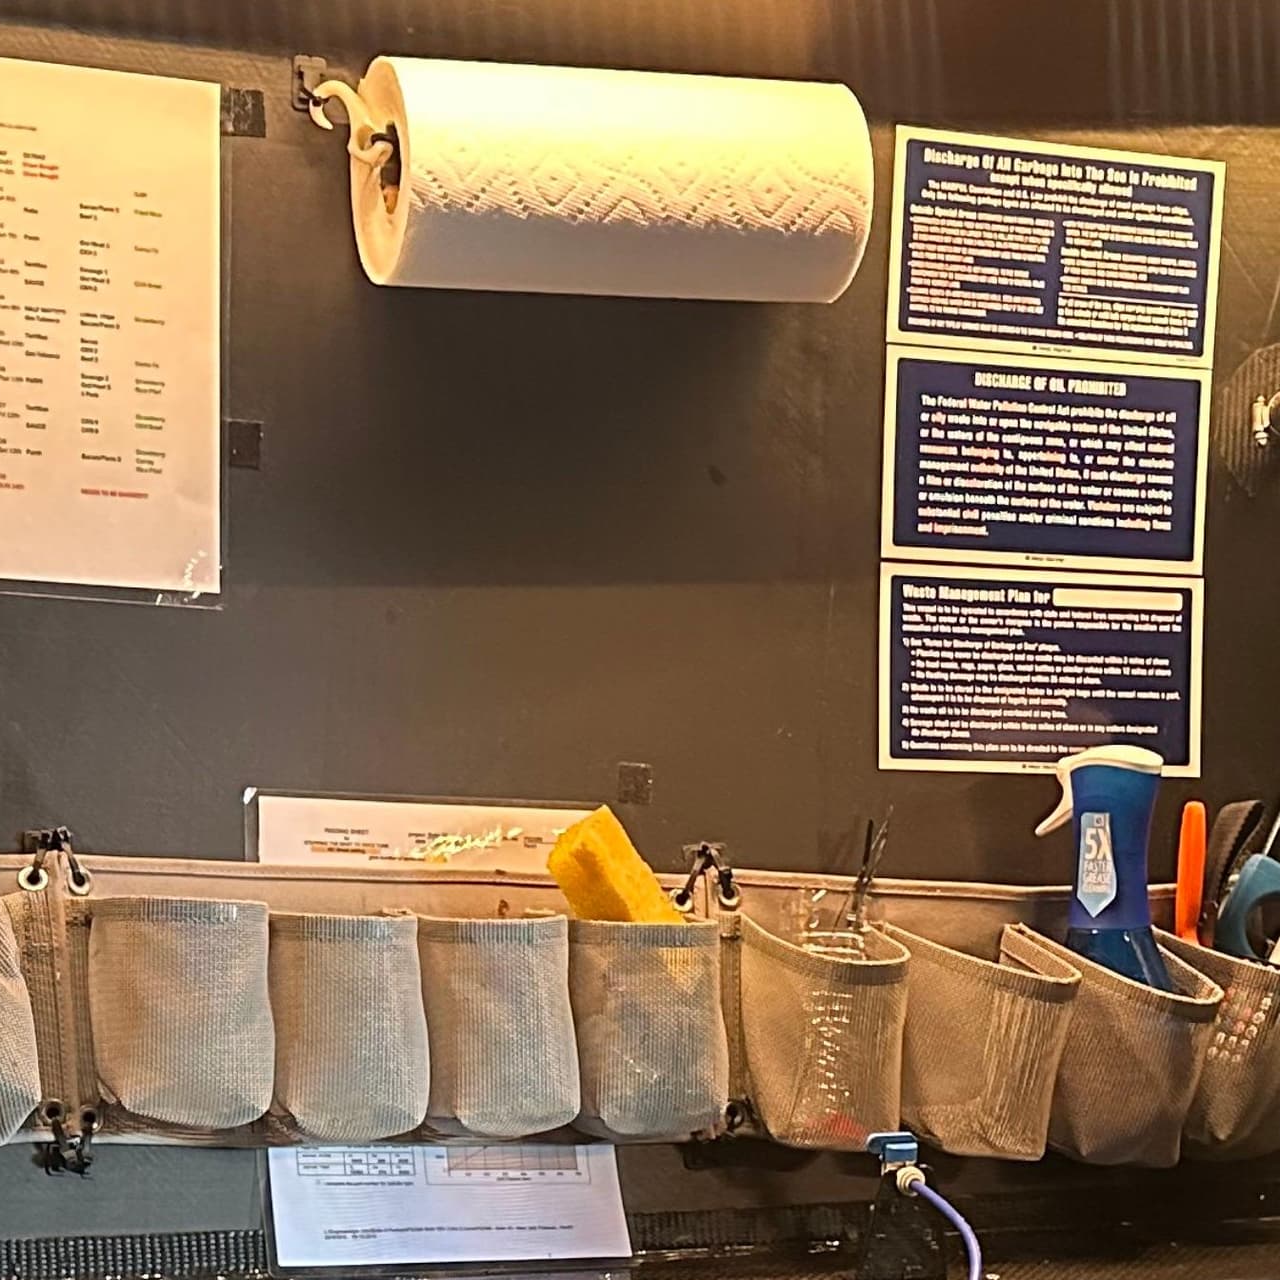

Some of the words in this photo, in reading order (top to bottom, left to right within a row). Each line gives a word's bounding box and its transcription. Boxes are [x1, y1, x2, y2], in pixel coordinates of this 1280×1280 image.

[923, 147, 979, 169] Discharge
[981, 154, 994, 169] Of
[996, 155, 1011, 171] All
[1013, 157, 1058, 177] Garbage
[1060, 162, 1082, 179] Into
[1085, 165, 1104, 181] The
[1106, 167, 1127, 183] Sea
[1141, 171, 1197, 191] Prohibited
[974, 371, 1031, 390] DISCHARGE
[1033, 376, 1047, 390] OF
[1049, 377, 1066, 392] OIL
[1067, 378, 1126, 396] PROHIBITED
[921, 394, 936, 406] The
[937, 395, 967, 408] Federal
[968, 398, 991, 410] Water
[1028, 402, 1056, 414] Control
[1104, 407, 1117, 418] the
[902, 583, 936, 599] Waste
[938, 585, 1005, 602] Management
[1007, 588, 1031, 603] Plan
[1032, 589, 1050, 603] for
[1084, 827, 1112, 860] 5X
